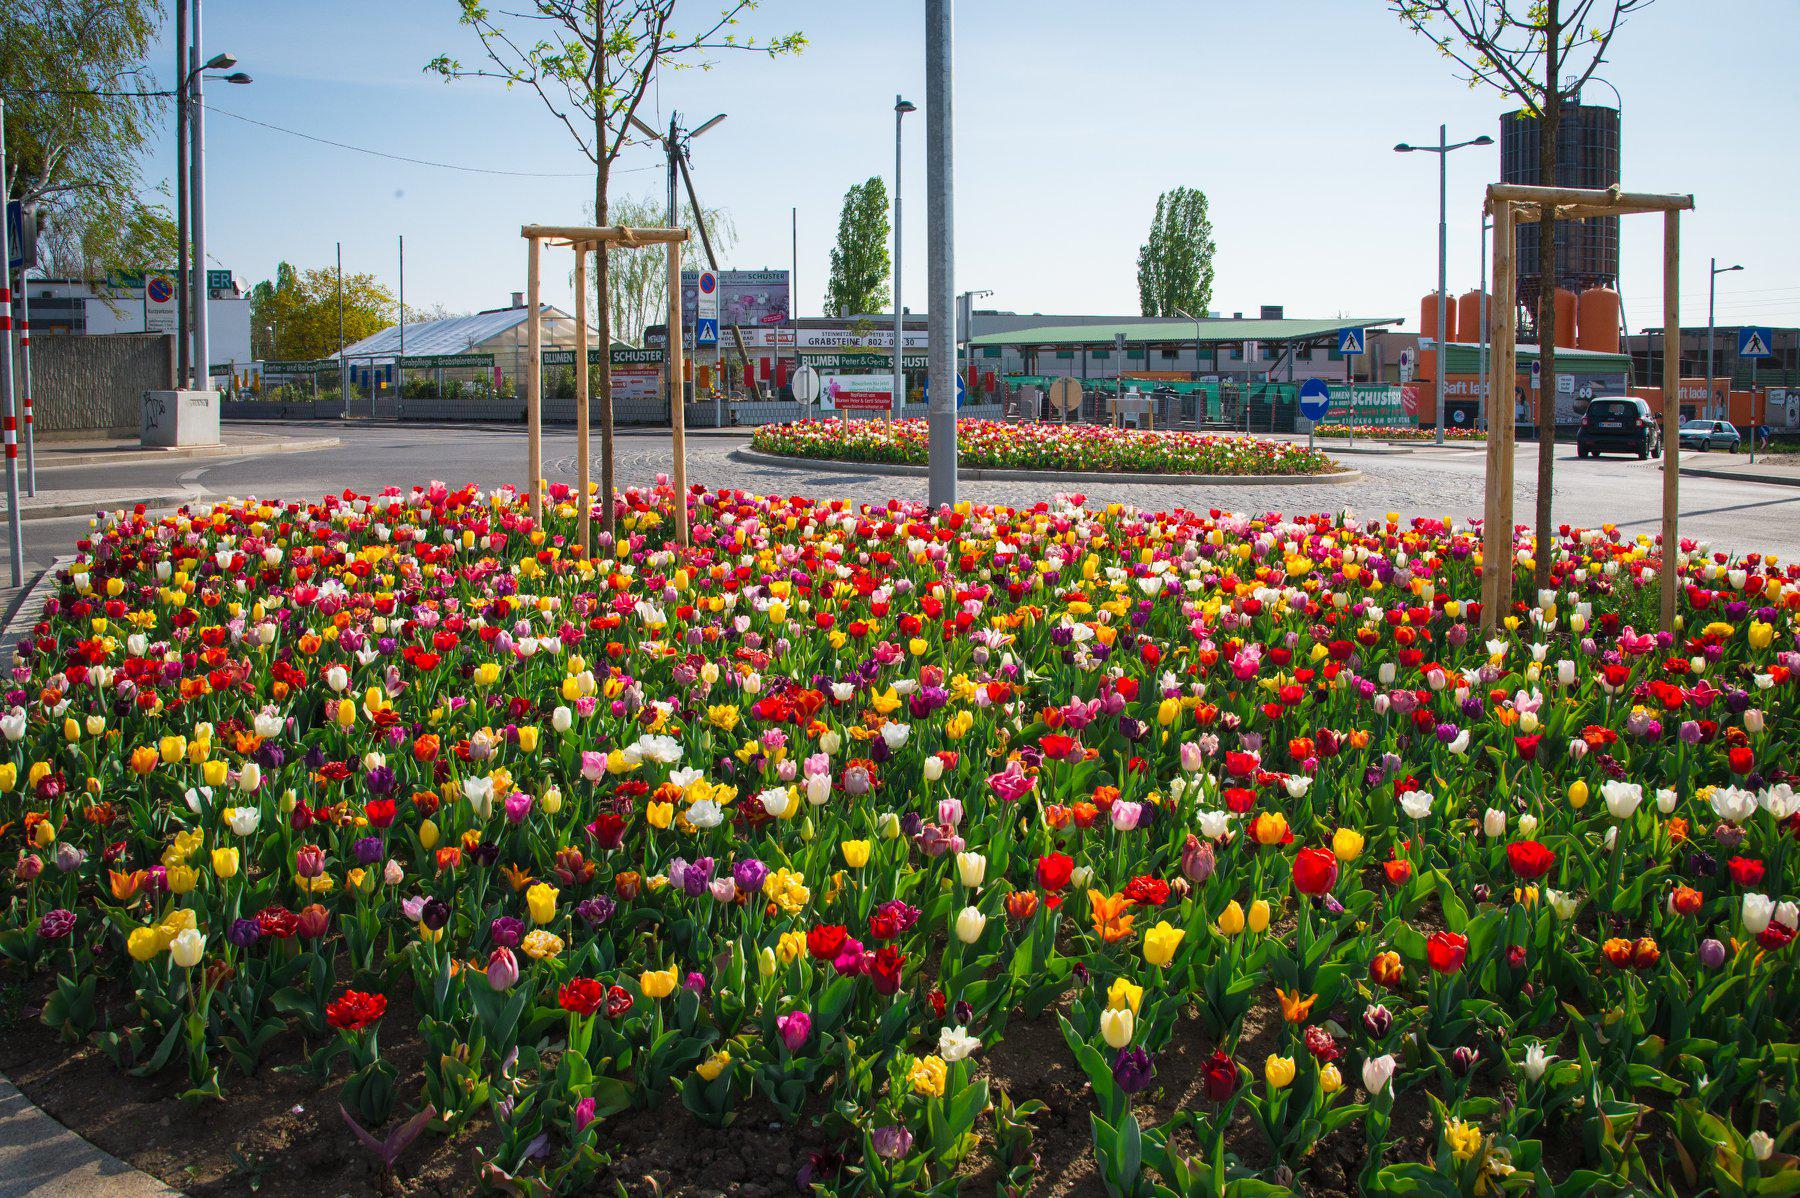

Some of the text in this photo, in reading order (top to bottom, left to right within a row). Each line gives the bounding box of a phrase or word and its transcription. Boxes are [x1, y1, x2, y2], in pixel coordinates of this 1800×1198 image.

[808, 338, 860, 346] GRABSTEINE
[544, 352, 574, 363] BLUMEN
[613, 350, 662, 362] SCHUSTER
[801, 355, 839, 366] BLUMEN
[841, 357, 860, 365] Peter
[400, 358, 432, 367] Grabpflege
[1352, 391, 1401, 406] SCHUSTER
